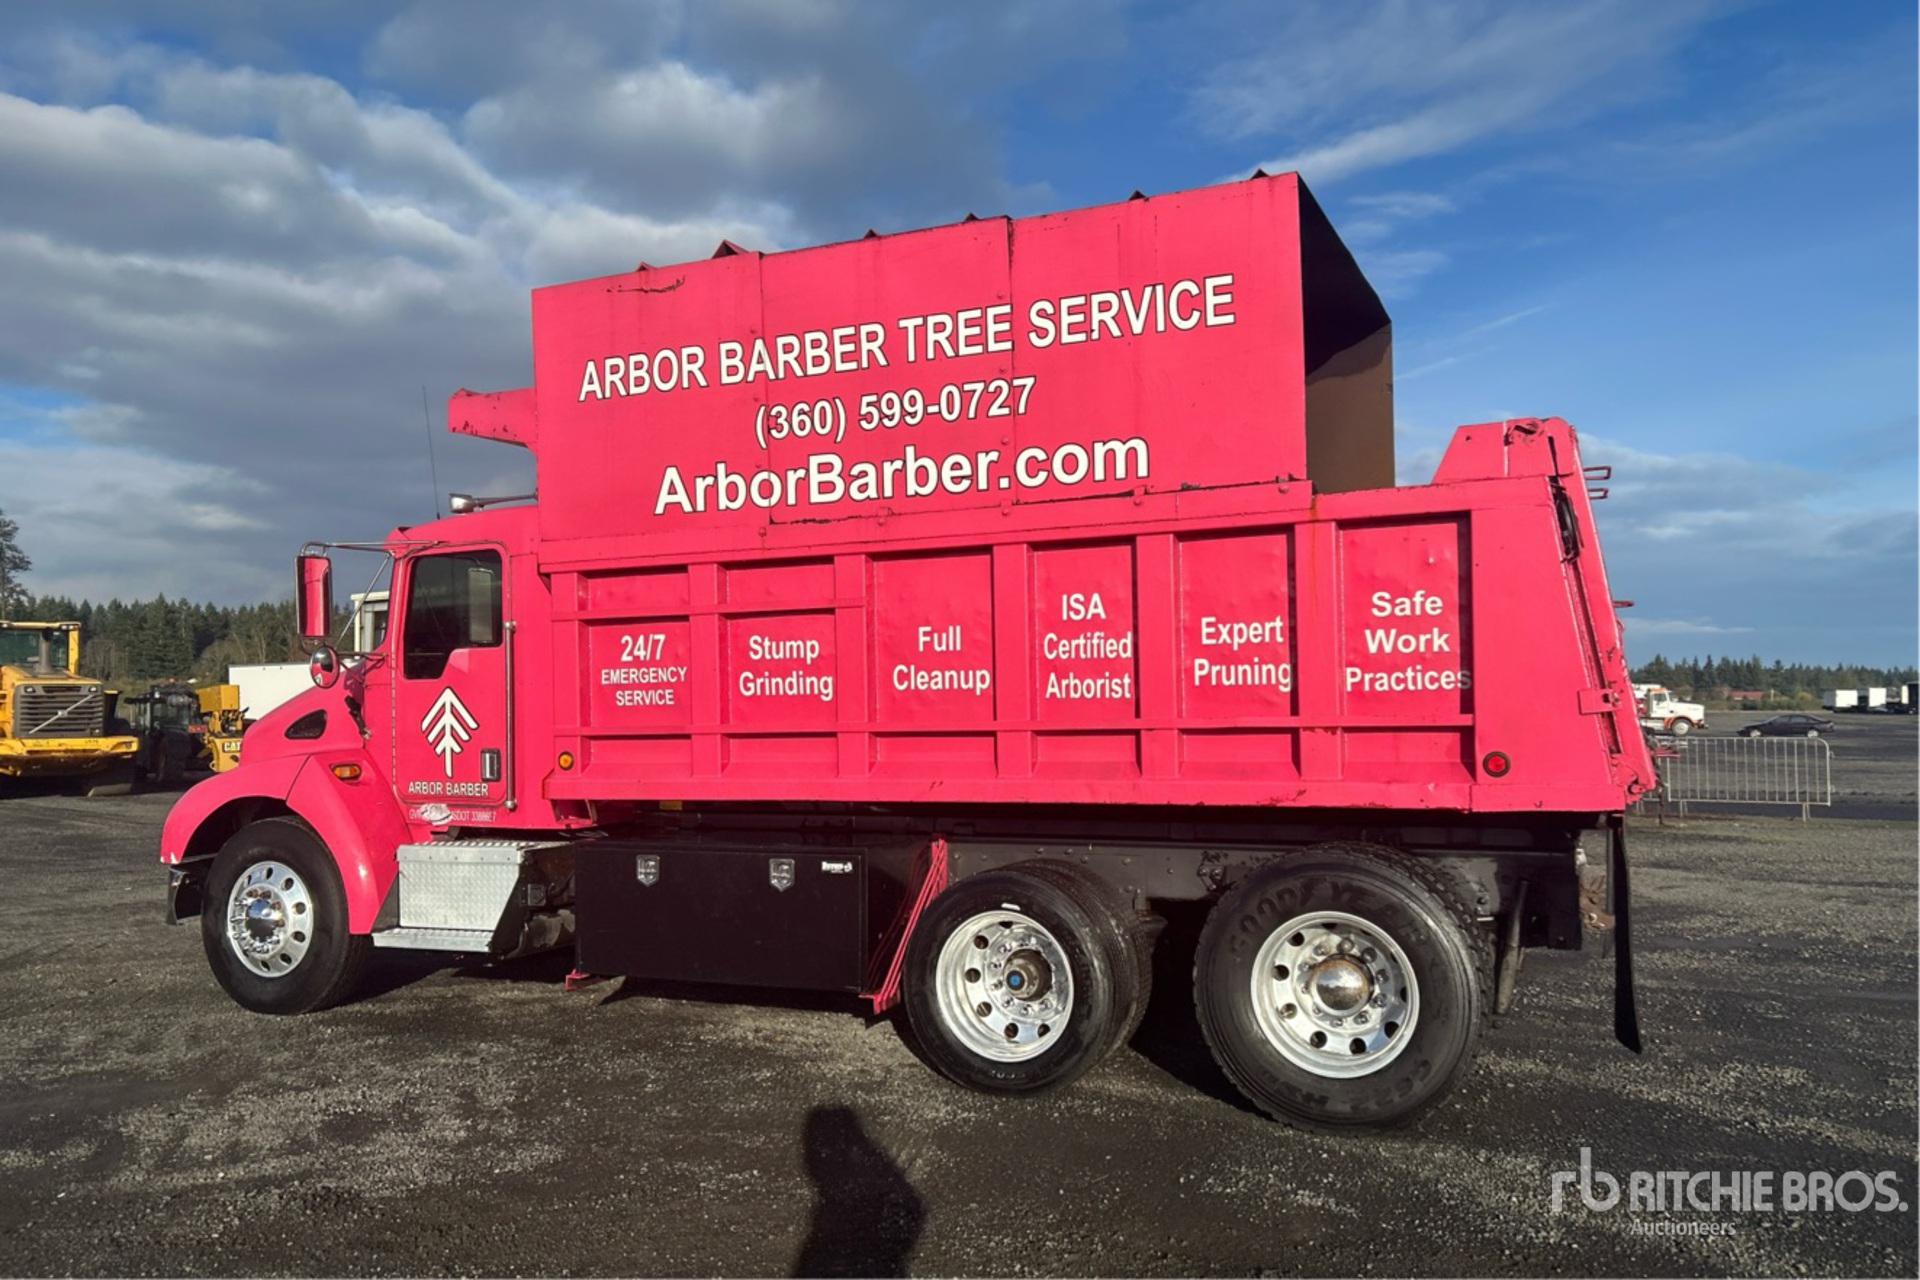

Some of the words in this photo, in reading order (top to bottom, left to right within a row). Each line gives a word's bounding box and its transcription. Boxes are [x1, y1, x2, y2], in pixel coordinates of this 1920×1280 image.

[578, 345, 709, 402] ARBOR
[718, 322, 889, 385] BARBER
[897, 303, 1014, 363] TREE
[1028, 274, 1237, 349] SERVICE
[755, 399, 847, 450] (360)
[858, 375, 1037, 432] 599-0727
[653, 437, 1150, 516] ArborBarber.com
[1061, 592, 1107, 621] ISA
[1371, 589, 1444, 618] Safe
[620, 633, 666, 662] 24/7
[917, 624, 962, 652] Full
[1043, 630, 1133, 660] Certified
[1200, 615, 1284, 651] Expert
[1364, 626, 1451, 654] Work
[748, 634, 820, 665] Stump
[601, 665, 688, 685] EMERGENCY
[738, 670, 834, 702] Grinding
[892, 664, 991, 696] Cleanup
[1045, 671, 1132, 699] Arborist
[1193, 656, 1293, 693] Pruning
[1345, 664, 1472, 692] Practices
[615, 688, 675, 706] SERVICE
[408, 781, 444, 795] ARBOR
[445, 782, 489, 797] BARBER
